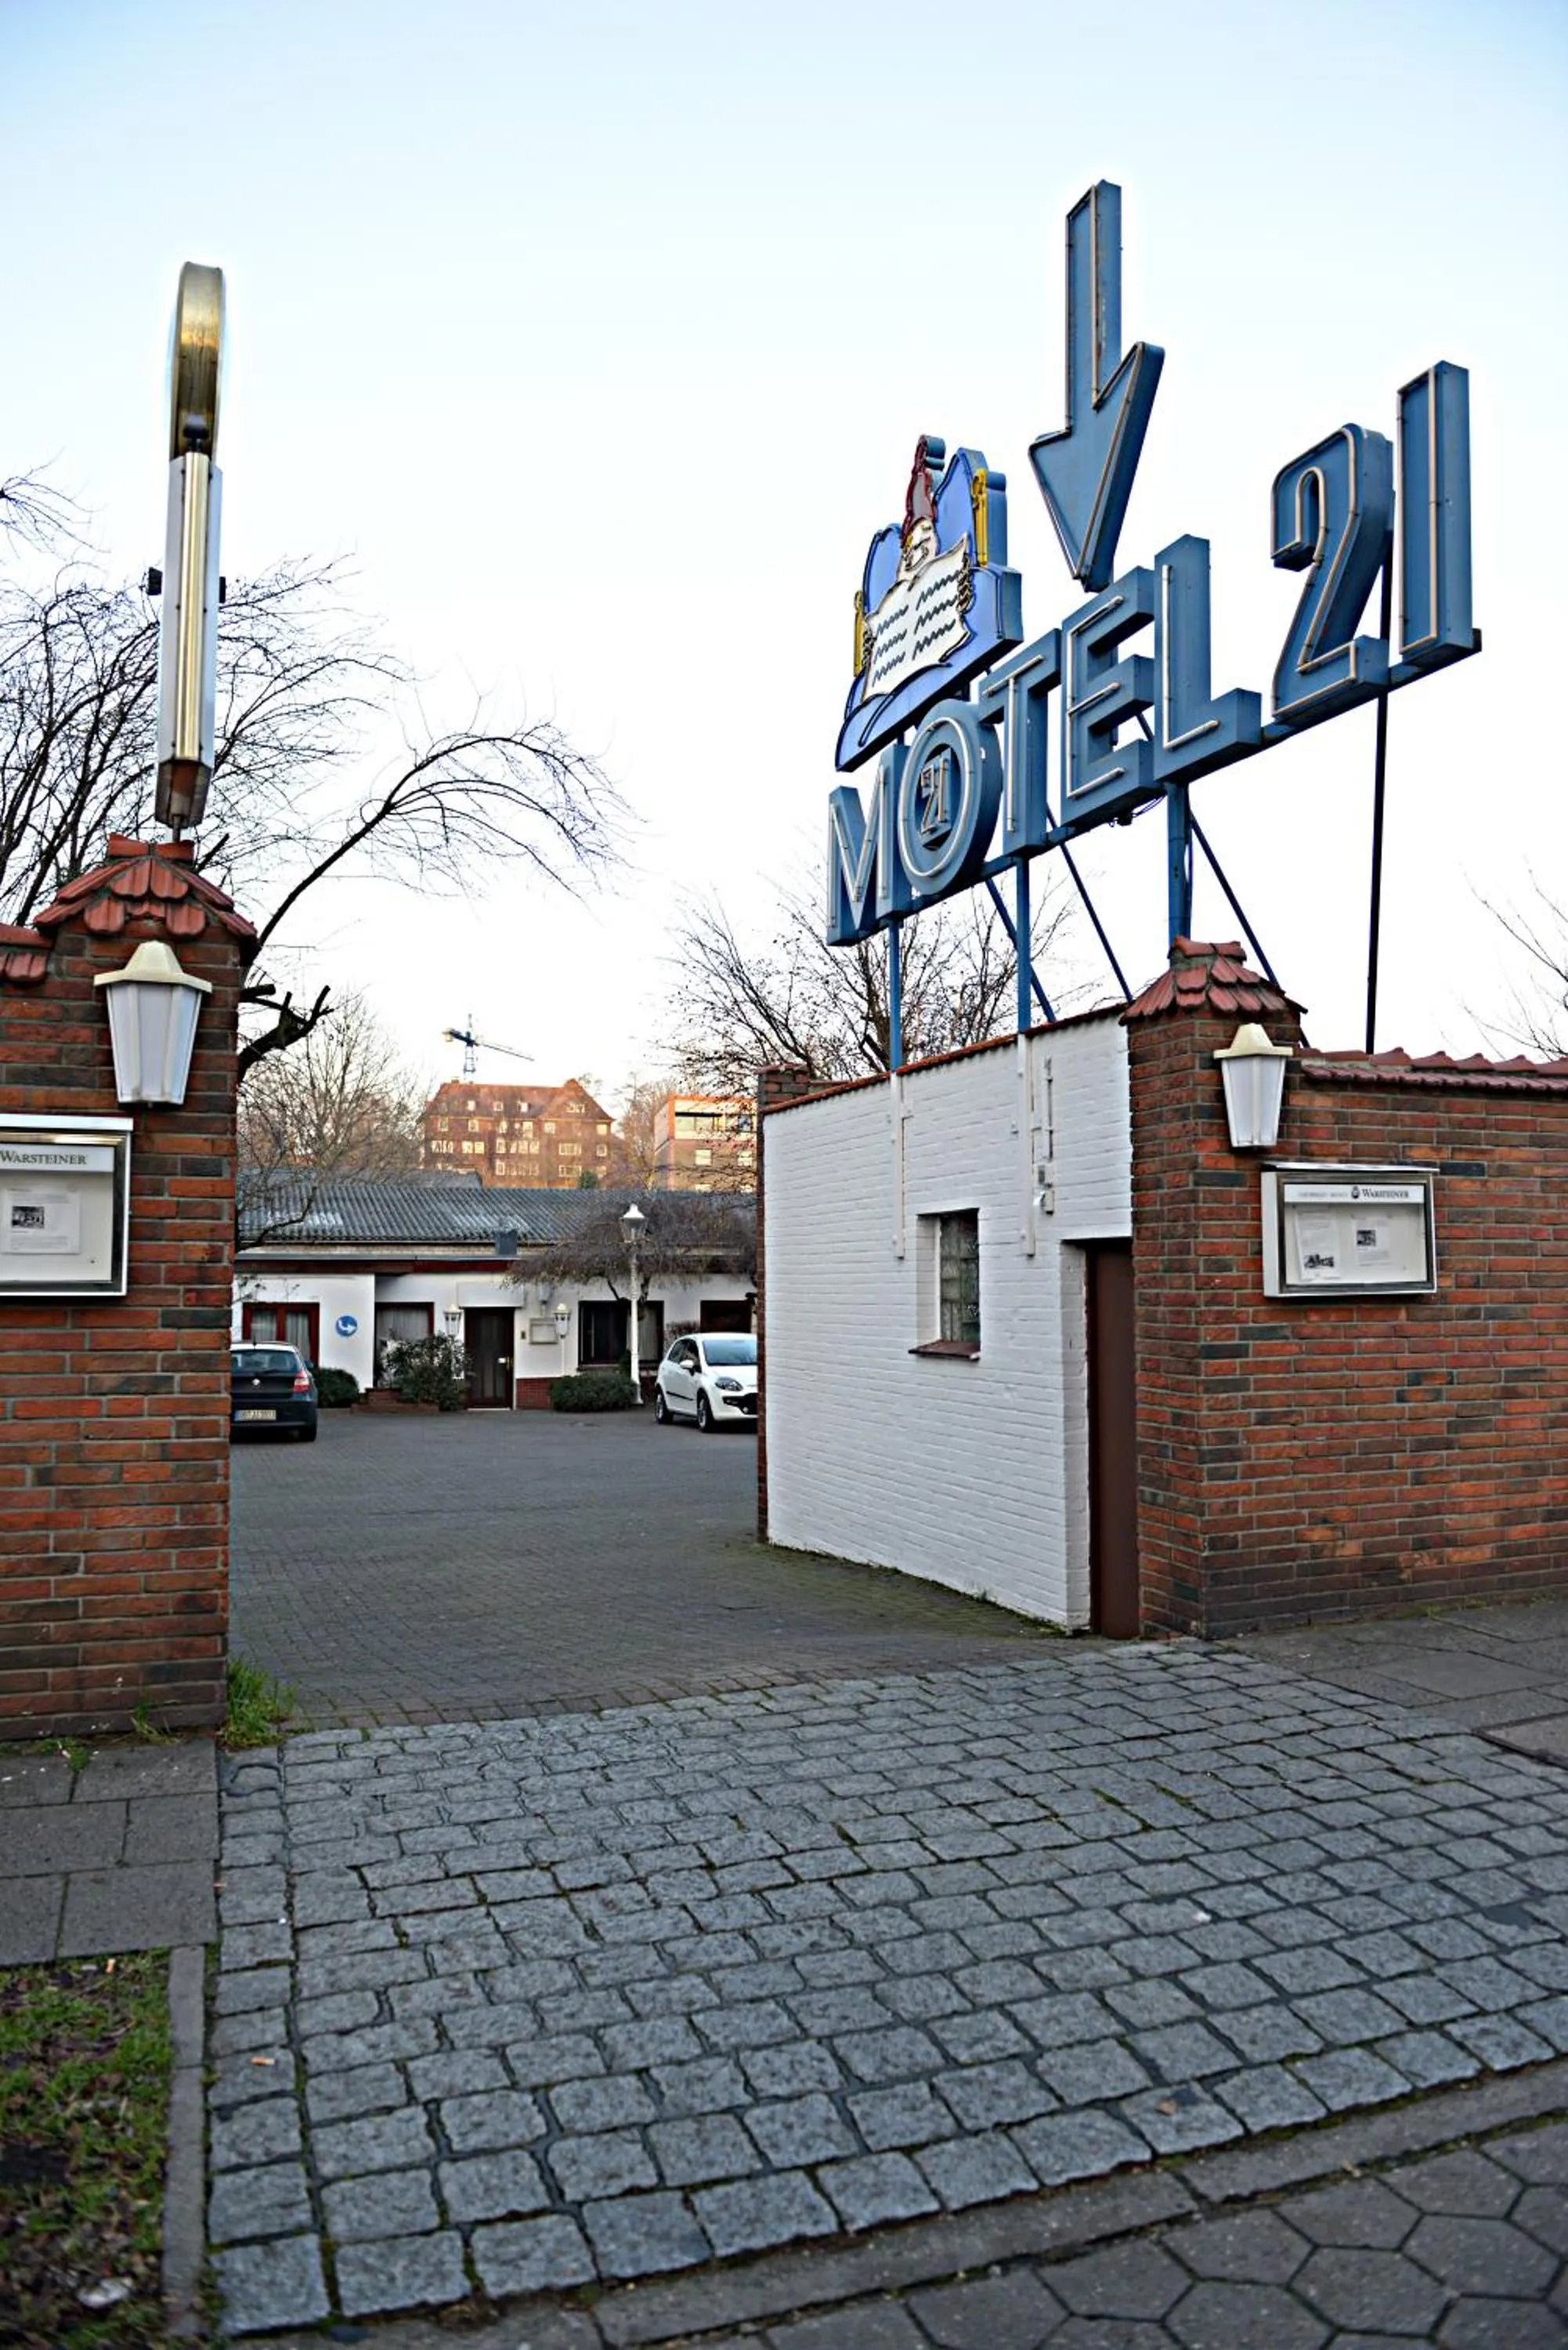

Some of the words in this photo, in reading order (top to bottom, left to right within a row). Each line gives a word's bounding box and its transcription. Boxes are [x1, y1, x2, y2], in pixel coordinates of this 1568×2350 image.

[826, 535, 1261, 946] MOTEL
[1270, 360, 1476, 721] 21
[919, 747, 953, 843] 21
[0, 1149, 87, 1165] WARSTEINER
